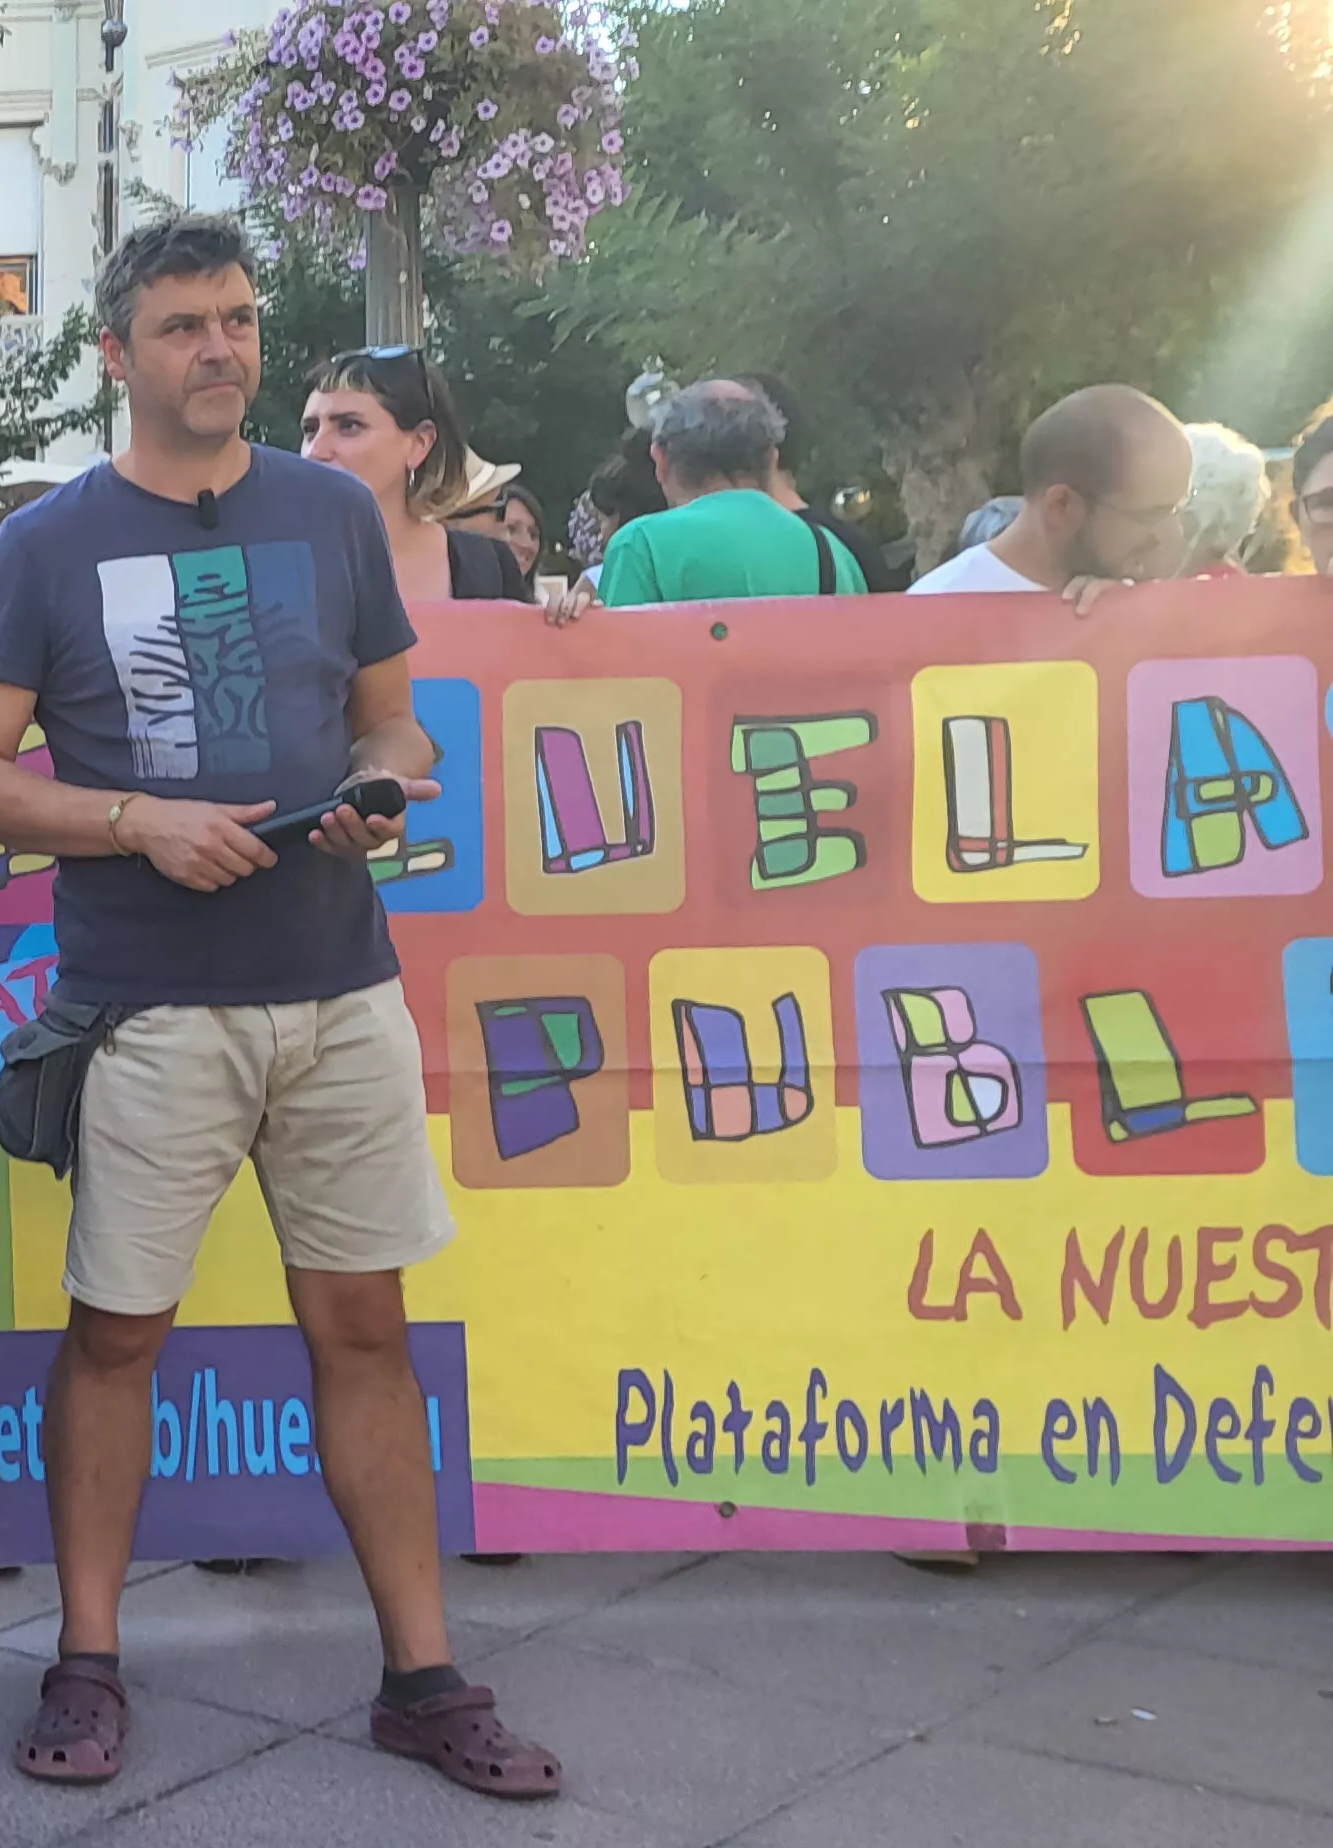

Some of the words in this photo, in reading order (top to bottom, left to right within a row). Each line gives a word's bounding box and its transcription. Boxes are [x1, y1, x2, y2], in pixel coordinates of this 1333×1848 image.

[476, 990, 1333, 1162] PUBL
[907, 1227, 1024, 1323] LA
[615, 1366, 1001, 1488] Plataforma
[1040, 1396, 1123, 1488] en
[1152, 1362, 1333, 1487] Defe
